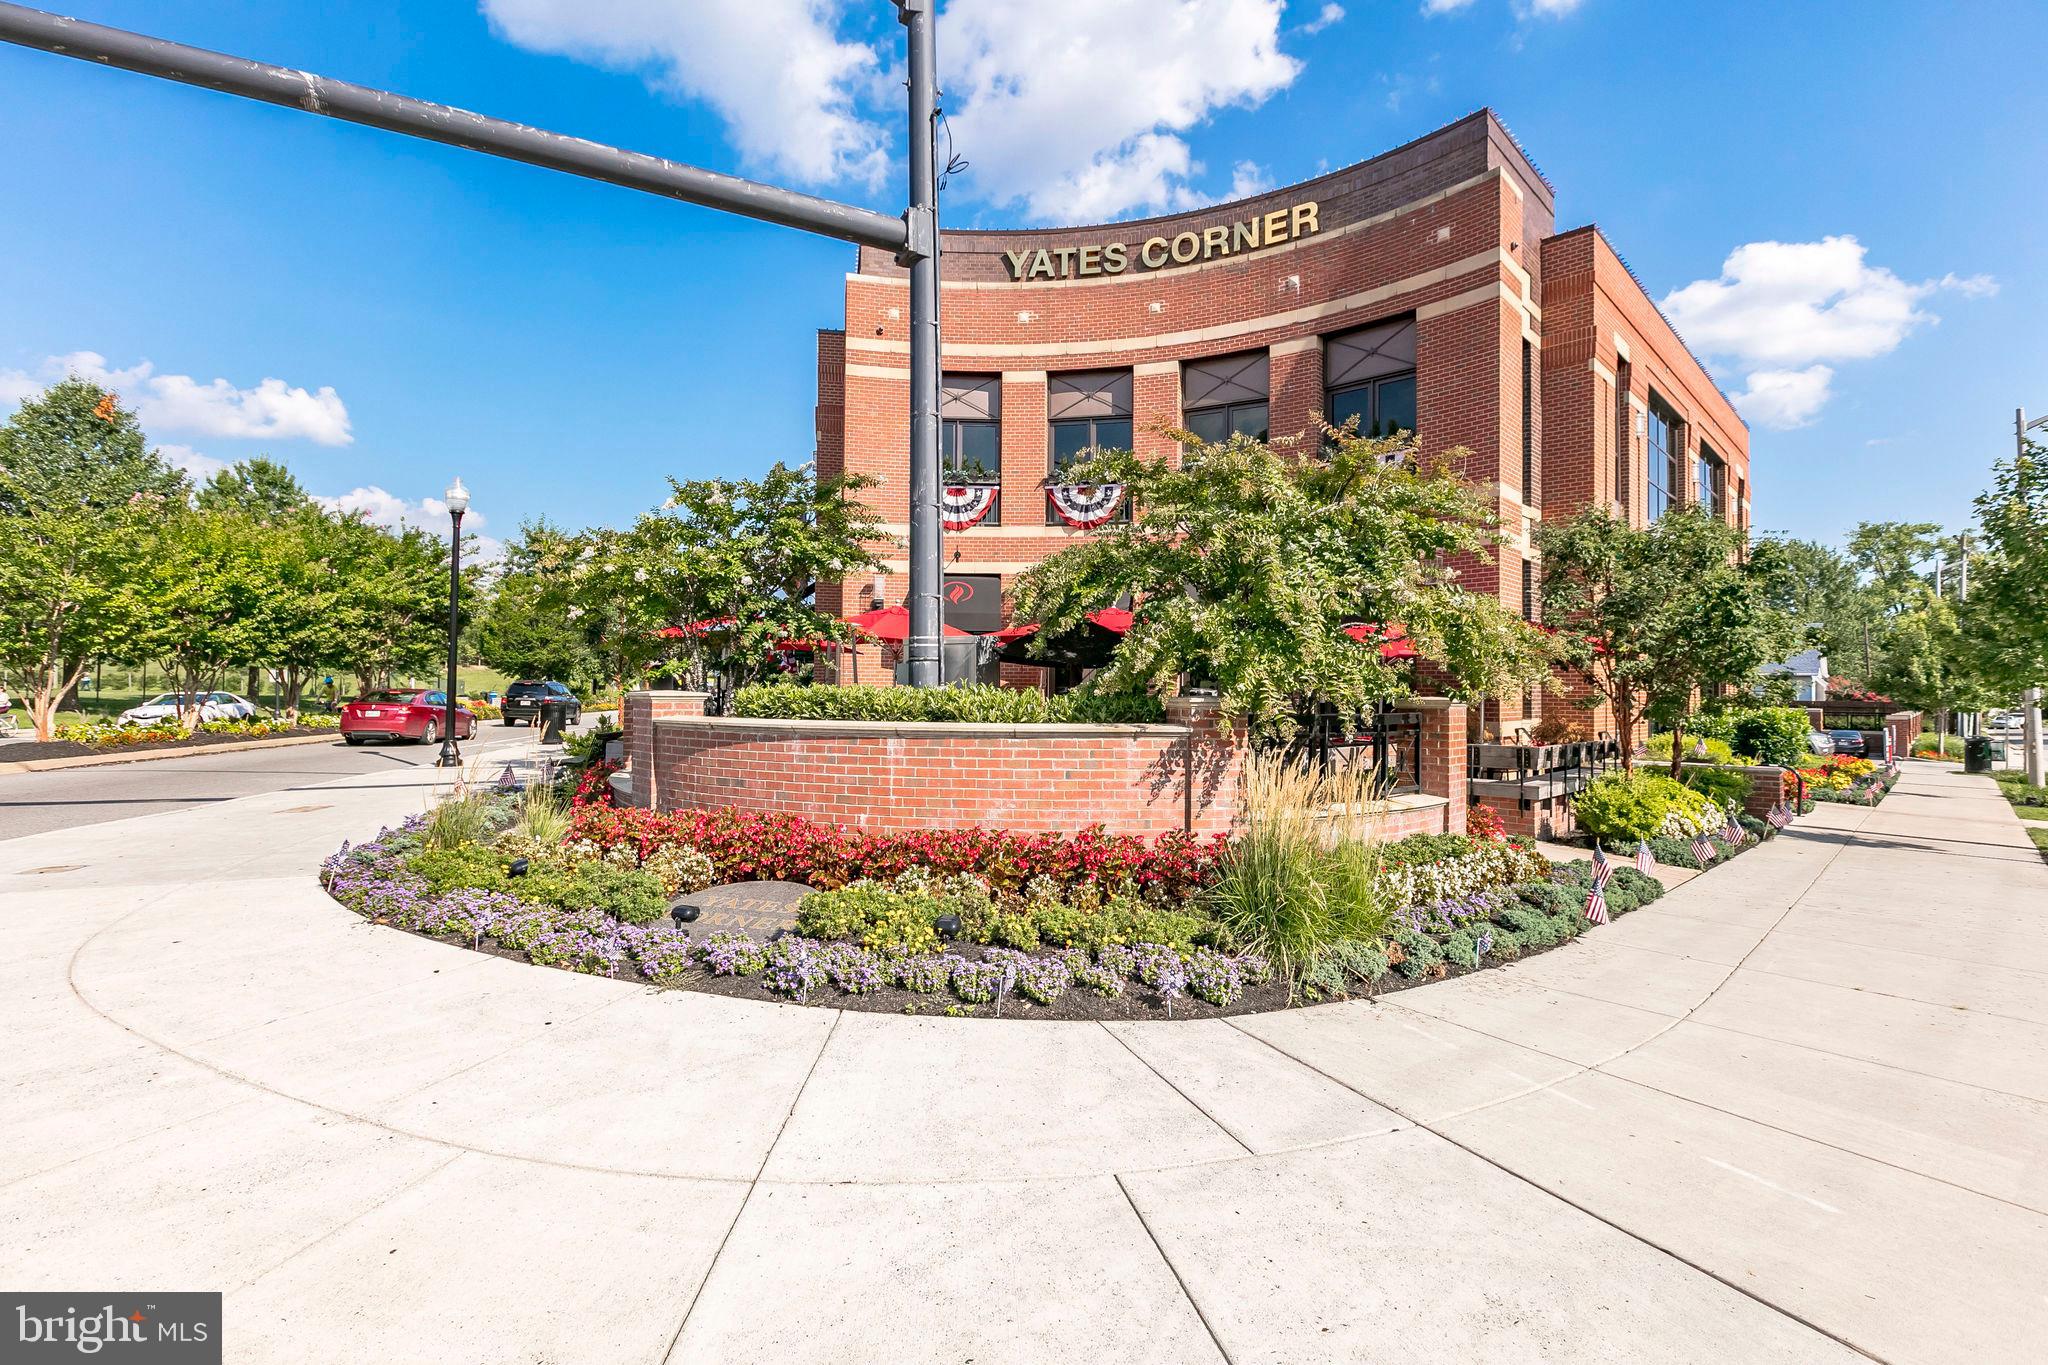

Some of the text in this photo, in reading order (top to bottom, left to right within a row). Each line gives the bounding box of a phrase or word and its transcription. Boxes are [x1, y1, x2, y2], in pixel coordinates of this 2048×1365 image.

[1006, 201, 1320, 279] YATES CORNER
[701, 895, 799, 914] YATES
[697, 911, 799, 931] ORNER
